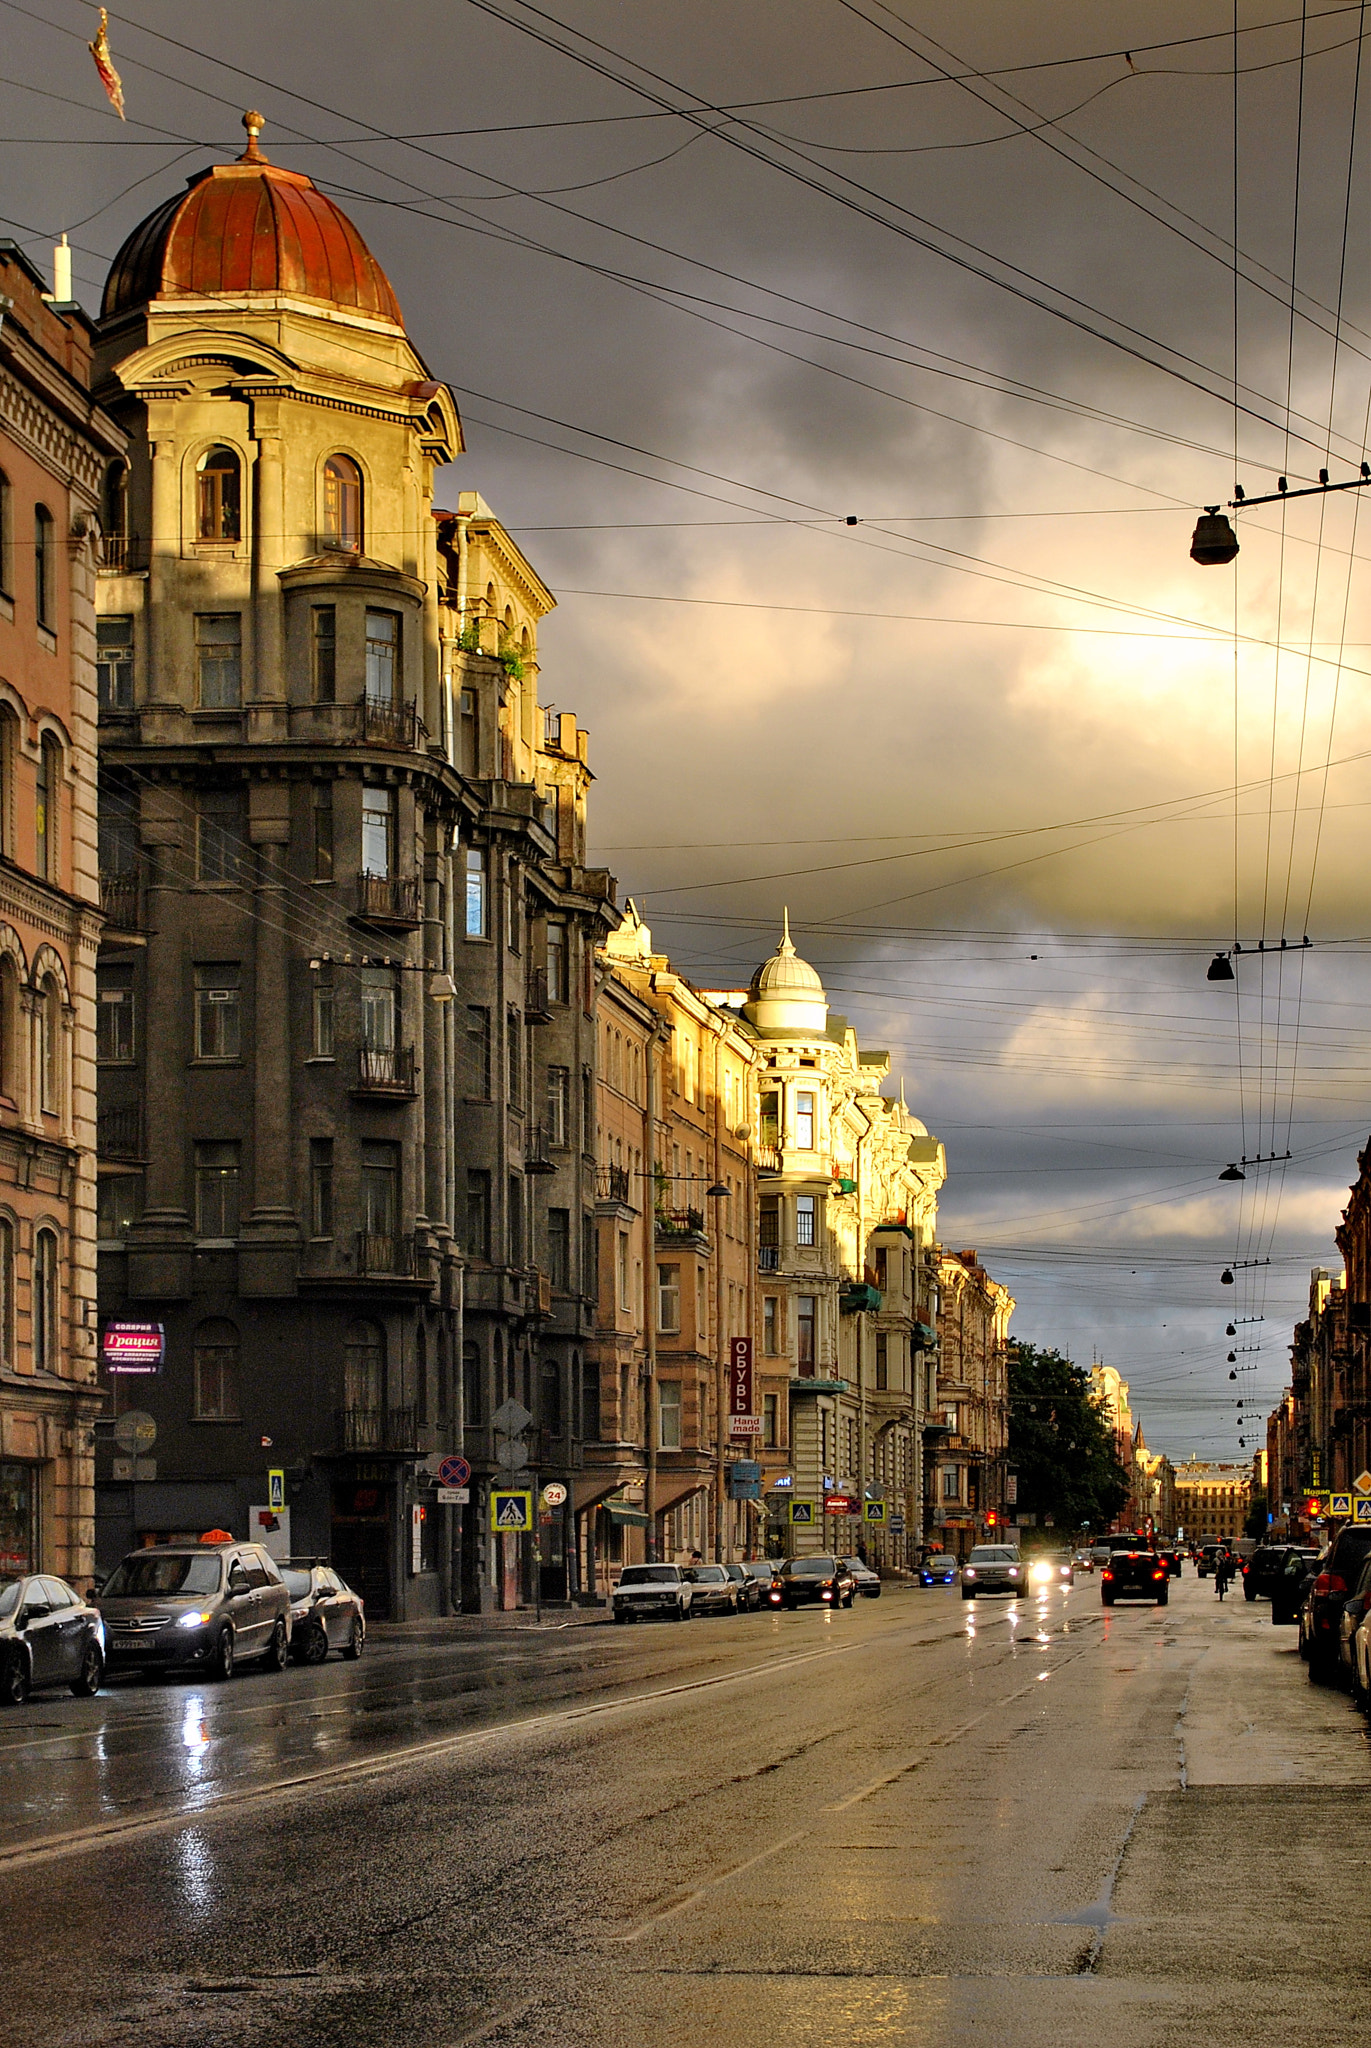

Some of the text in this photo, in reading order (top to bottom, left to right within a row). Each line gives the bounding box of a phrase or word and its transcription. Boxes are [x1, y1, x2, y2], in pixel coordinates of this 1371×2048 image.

[108, 1335, 158, 1348] Грация
[736, 1341, 748, 1411] ОБУВЬ
[734, 1417, 760, 1425] Hand
[733, 1425, 760, 1433] made
[548, 1491, 561, 1499] 24
